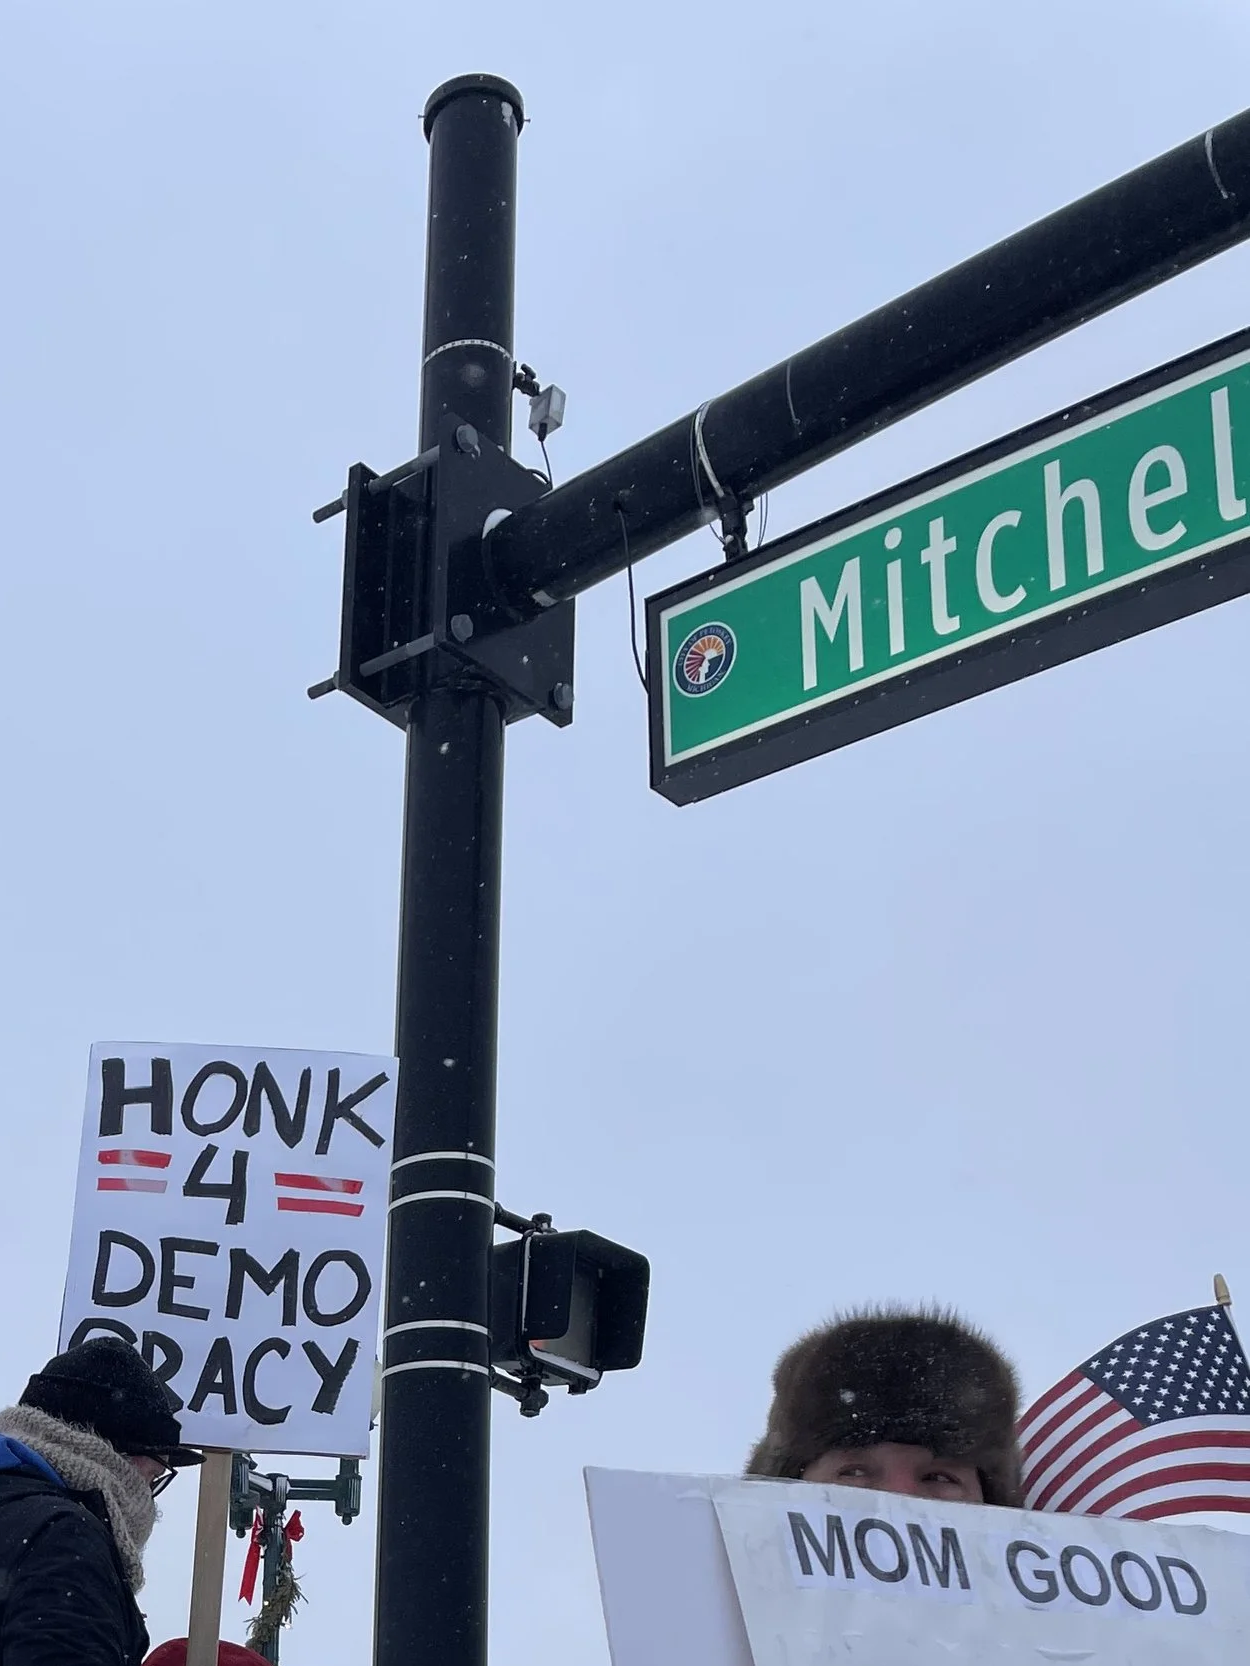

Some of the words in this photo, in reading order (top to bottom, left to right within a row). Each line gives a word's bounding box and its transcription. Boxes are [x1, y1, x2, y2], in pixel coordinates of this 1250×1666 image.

[799, 386, 1246, 691] Mitchel
[98, 1057, 390, 1155] HONK
[183, 1143, 249, 1225] 4
[91, 1230, 372, 1327] DEMO
[786, 1512, 970, 1590] MOM
[1006, 1540, 1207, 1616] GOOD
